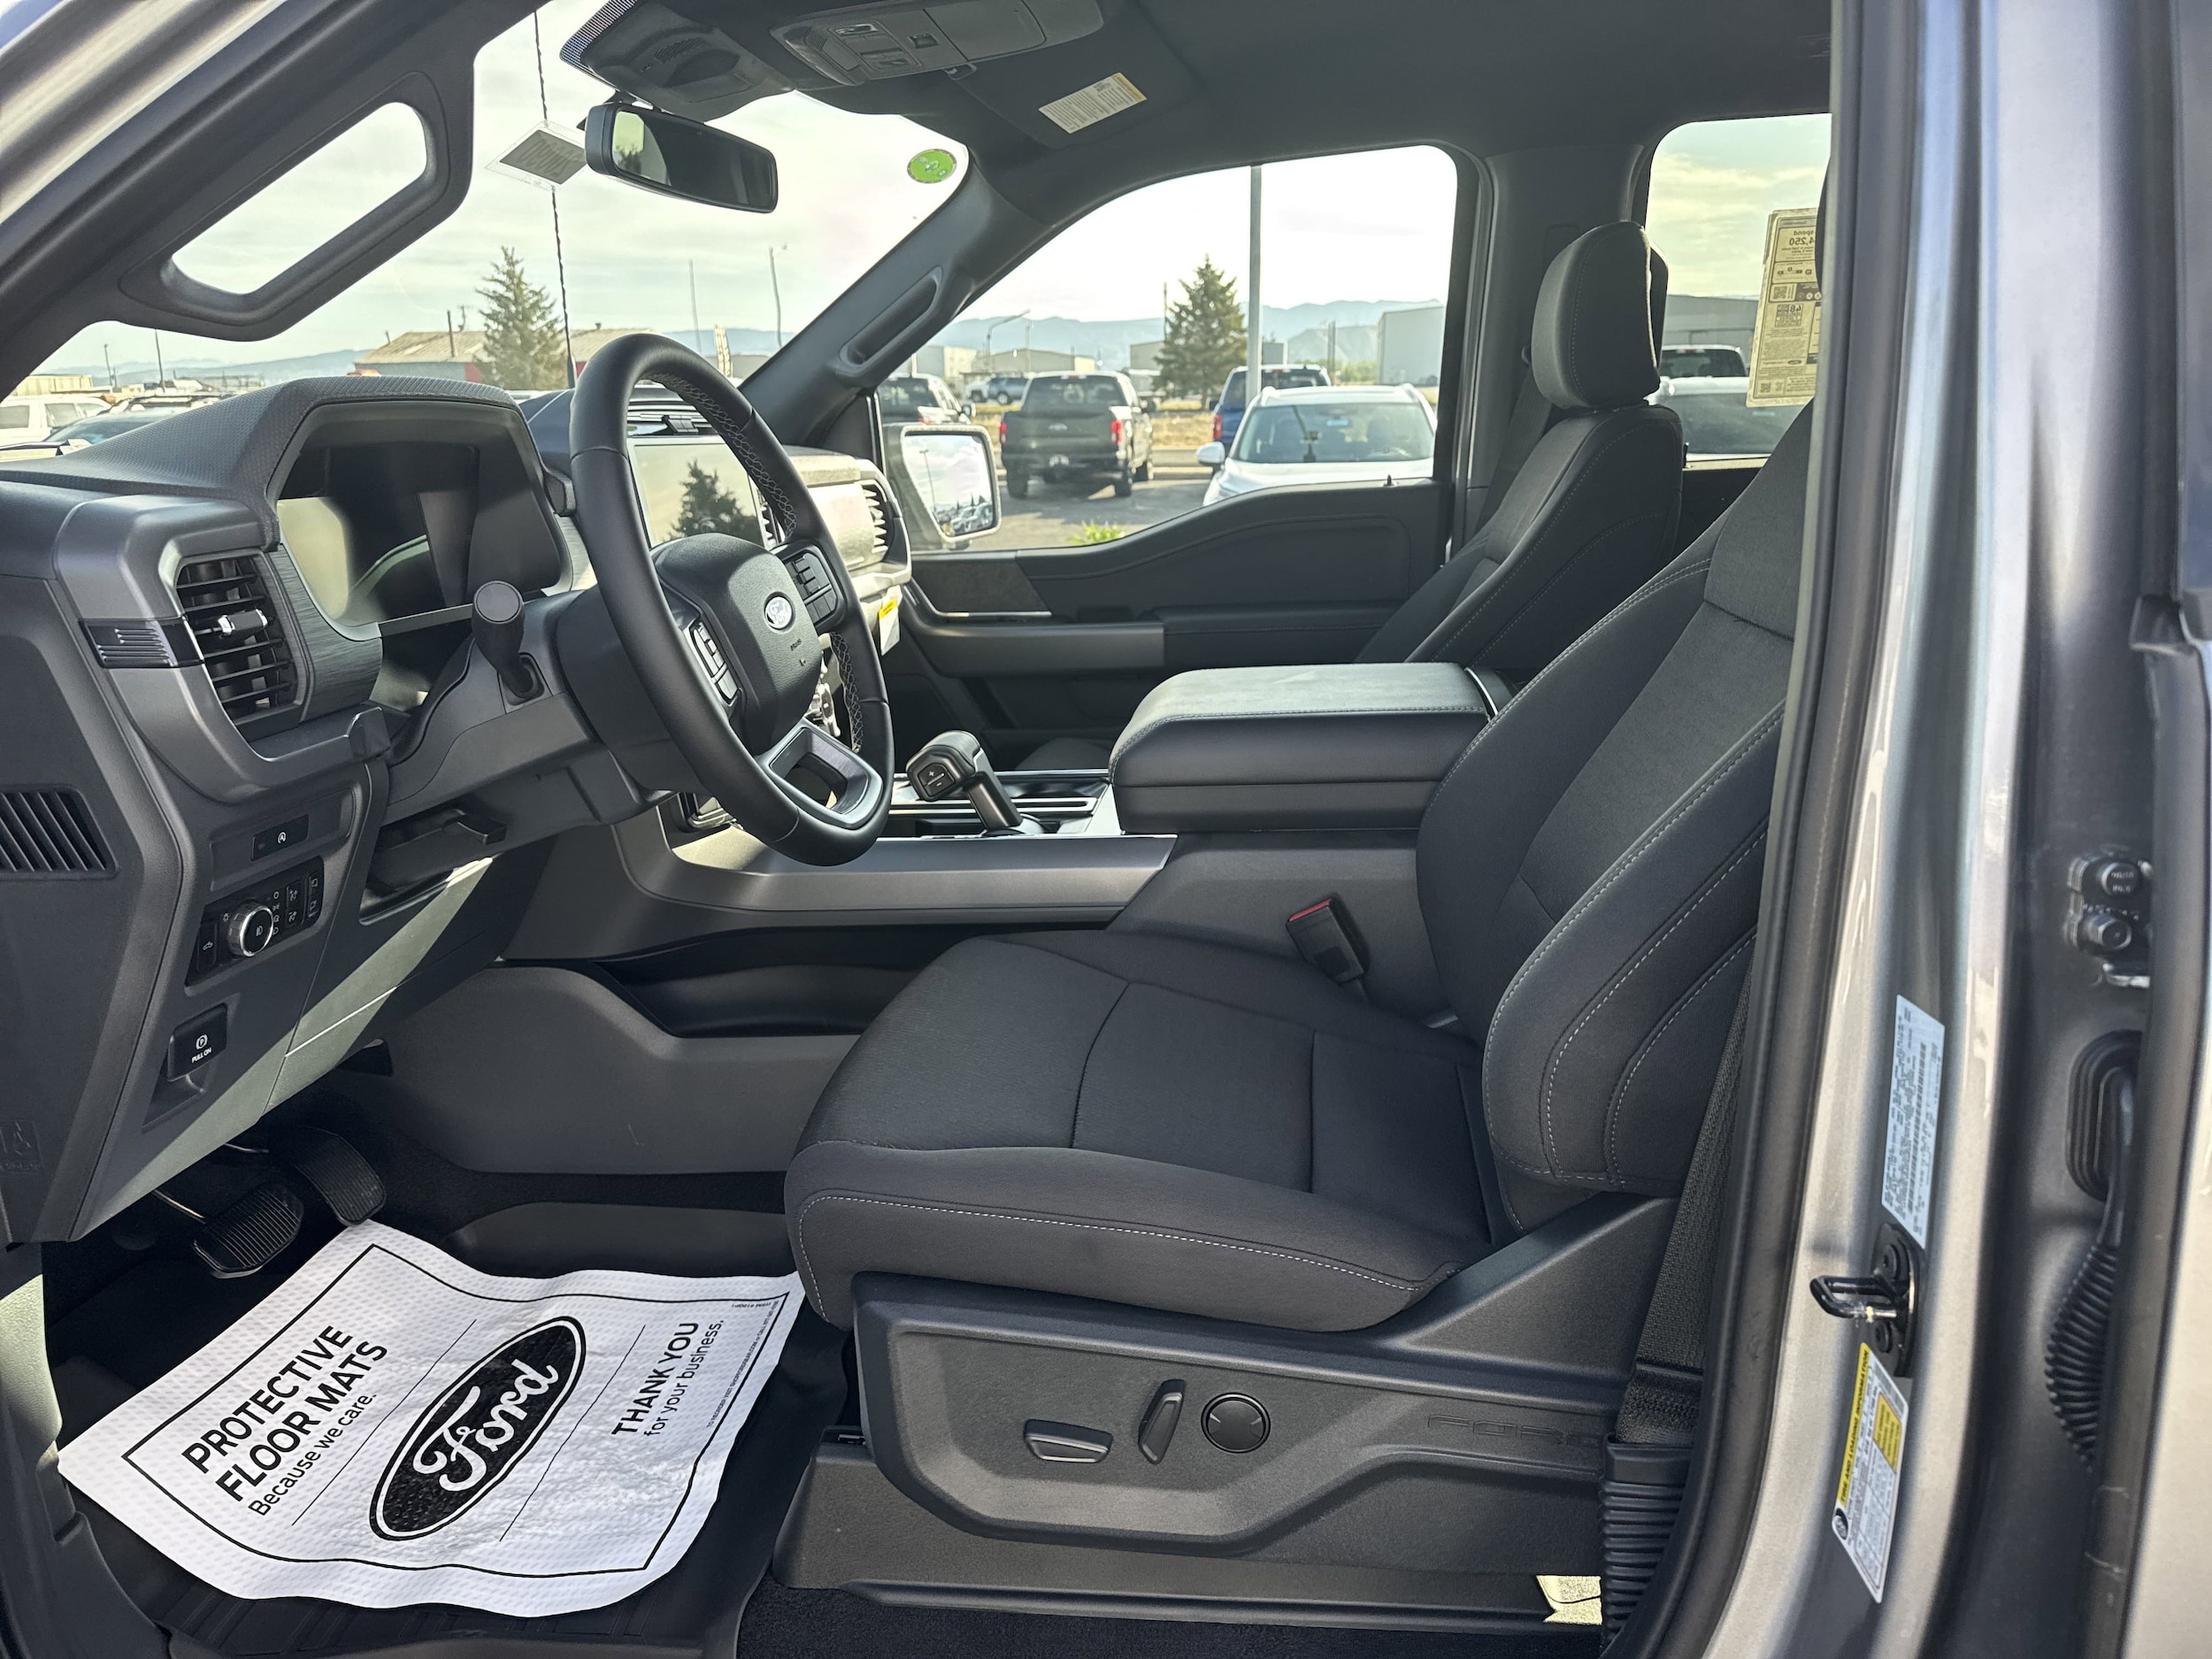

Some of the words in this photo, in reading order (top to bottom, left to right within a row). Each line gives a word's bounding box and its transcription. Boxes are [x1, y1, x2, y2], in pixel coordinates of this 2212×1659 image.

[191, 1052, 204, 1064] PULL
[204, 1047, 212, 1056] ON
[180, 1325, 354, 1474] PROTECTIVE
[215, 1410, 321, 1502] FLOOR
[303, 1340, 388, 1412] MATS
[413, 1359, 559, 1493] Ford
[611, 1367, 675, 1436] THANK
[657, 1323, 699, 1364] YOU
[644, 1416, 670, 1437] for
[660, 1382, 688, 1414] your
[676, 1319, 725, 1379] business.
[248, 1451, 322, 1516] Because
[313, 1428, 344, 1448] we
[337, 1392, 378, 1427] care.
